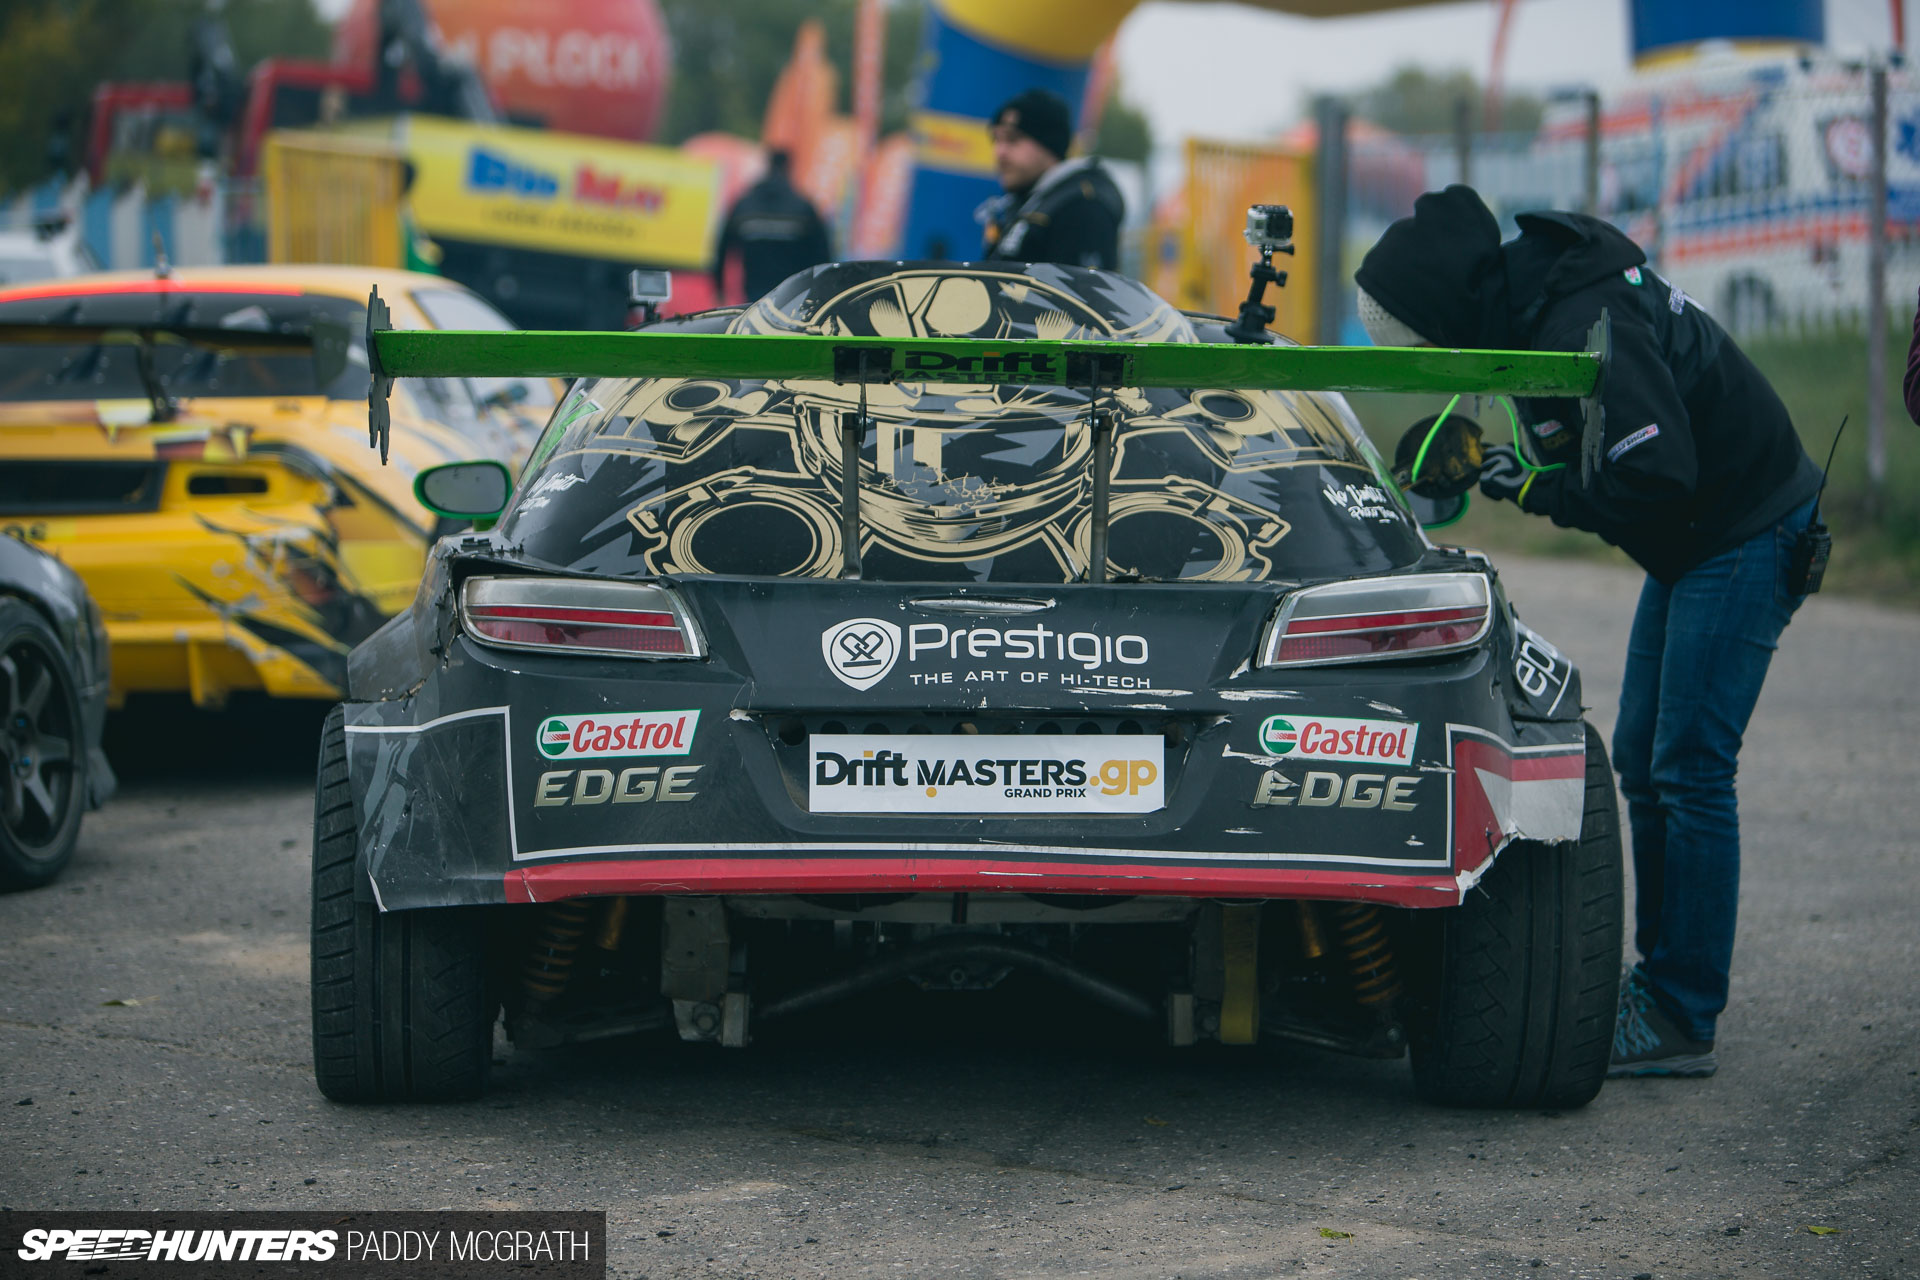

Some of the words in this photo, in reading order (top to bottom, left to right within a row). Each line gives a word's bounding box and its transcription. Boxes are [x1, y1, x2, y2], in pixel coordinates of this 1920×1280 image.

[905, 351, 1057, 373] Drift
[908, 623, 1149, 670] Prestigio
[910, 673, 953, 686] THE
[964, 670, 1009, 683] ART
[1020, 672, 1049, 684] OF
[1060, 673, 1150, 689] HI-TECH
[573, 716, 686, 753] Castrol
[1300, 722, 1408, 759] Castrol
[534, 764, 706, 807] EDGE
[816, 750, 908, 786] Drift
[1004, 788, 1053, 799] GRAND
[1056, 788, 1087, 799] PRIX
[1253, 769, 1424, 812] EDGE
